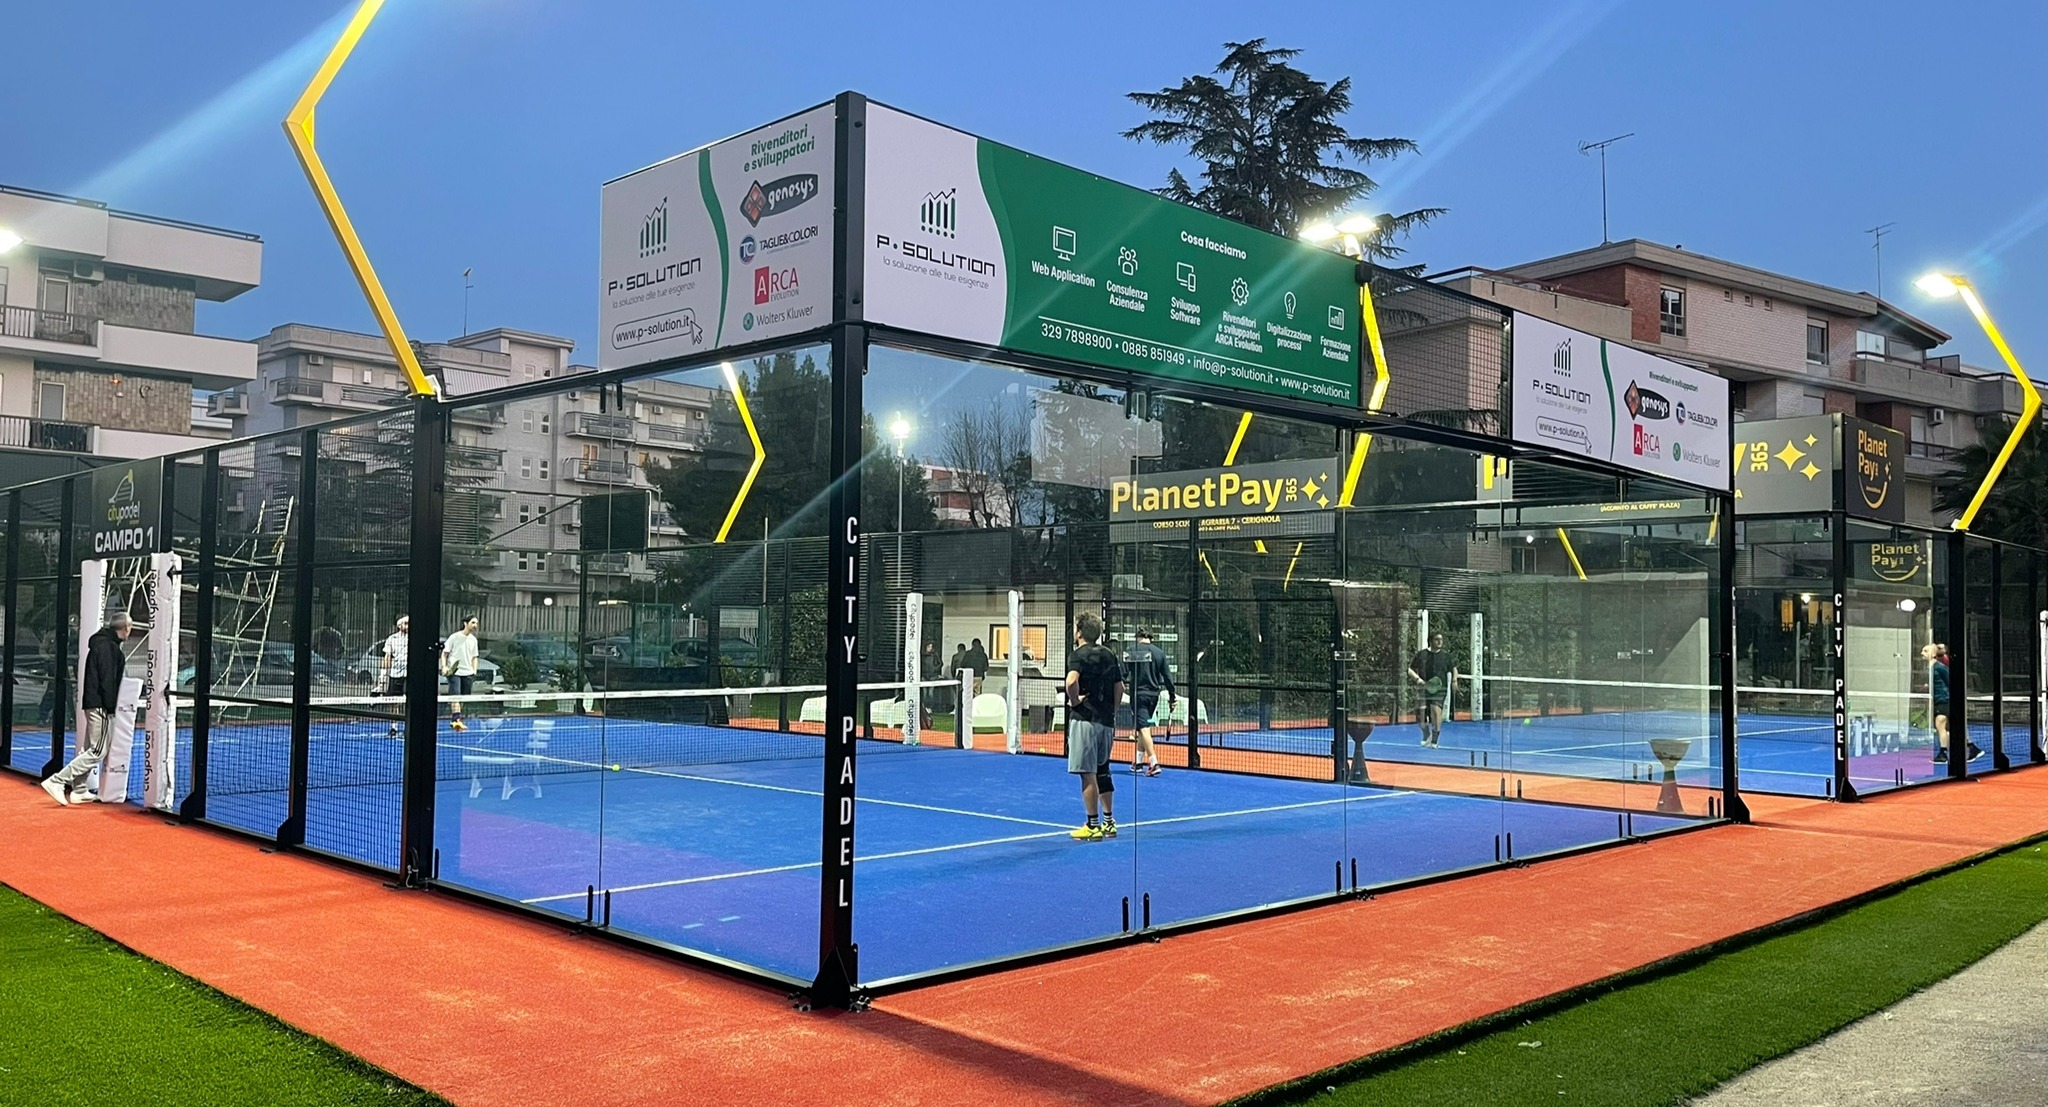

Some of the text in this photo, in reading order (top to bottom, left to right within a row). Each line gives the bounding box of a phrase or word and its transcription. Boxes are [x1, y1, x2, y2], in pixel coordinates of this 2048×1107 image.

[751, 123, 808, 156] Rivenditori
[743, 135, 815, 172] e sviluppatori
[768, 178, 814, 211] genesys
[1180, 230, 1247, 260] Cosa facciamo
[883, 255, 989, 289] la soluzione alle tue esigenze
[1031, 259, 1096, 288] Web Application
[1106, 280, 1148, 301] Consulenza
[1109, 294, 1145, 313] Aziendale
[1171, 296, 1201, 315] Sviluppo
[756, 305, 814, 326] Wolters Kluwer
[1170, 309, 1201, 326] Software
[1222, 310, 1257, 329] Rivenditori
[616, 314, 690, 342] www.p-solution.it
[1223, 324, 1261, 341] sviluppatori
[1266, 322, 1312, 343] Digitalizzazione
[1215, 332, 1263, 354] ARCA Evolution
[1276, 338, 1302, 352] processi
[1320, 335, 1351, 352] Formazione
[1322, 347, 1349, 362] Aziendale
[1041, 322, 1350, 400] 329 7898900 0885 851949 info@p-solution.it www.p-solution.it
[1641, 396, 1668, 417] genesys
[1858, 429, 1888, 458] Planet
[1750, 441, 1769, 472] 365
[1858, 452, 1876, 482] Pay
[1285, 477, 1298, 502] 365
[94, 526, 154, 553] CAMPO 1
[1871, 543, 1920, 555] Planet
[1871, 555, 1898, 568] Pay
[1834, 593, 1844, 761] CITY PADEL
[839, 516, 858, 907] CITY PADEL
